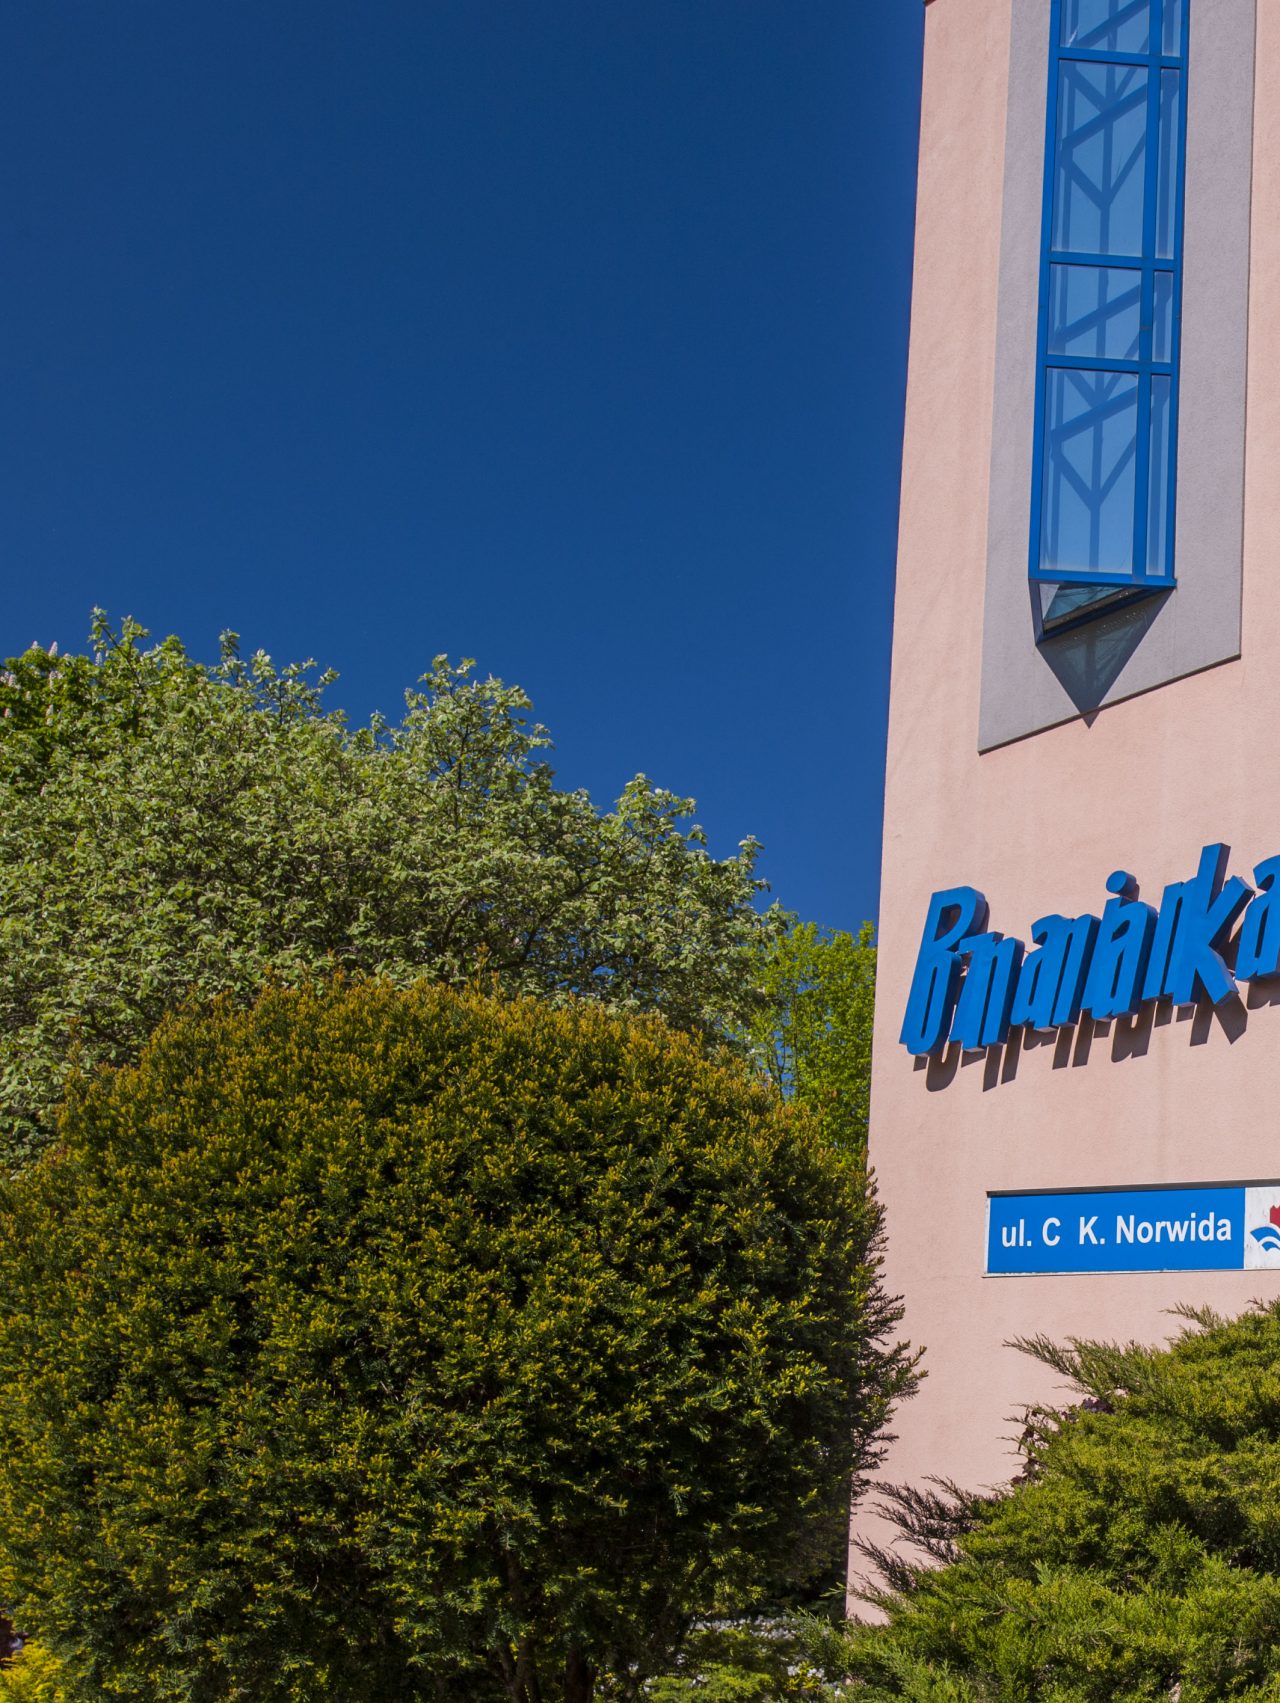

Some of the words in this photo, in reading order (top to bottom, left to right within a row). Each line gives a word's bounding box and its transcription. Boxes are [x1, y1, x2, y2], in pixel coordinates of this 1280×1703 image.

[1001, 1218, 1032, 1248] ul.
[1078, 1215, 1106, 1245] K.
[1116, 1212, 1232, 1244] Norwida
